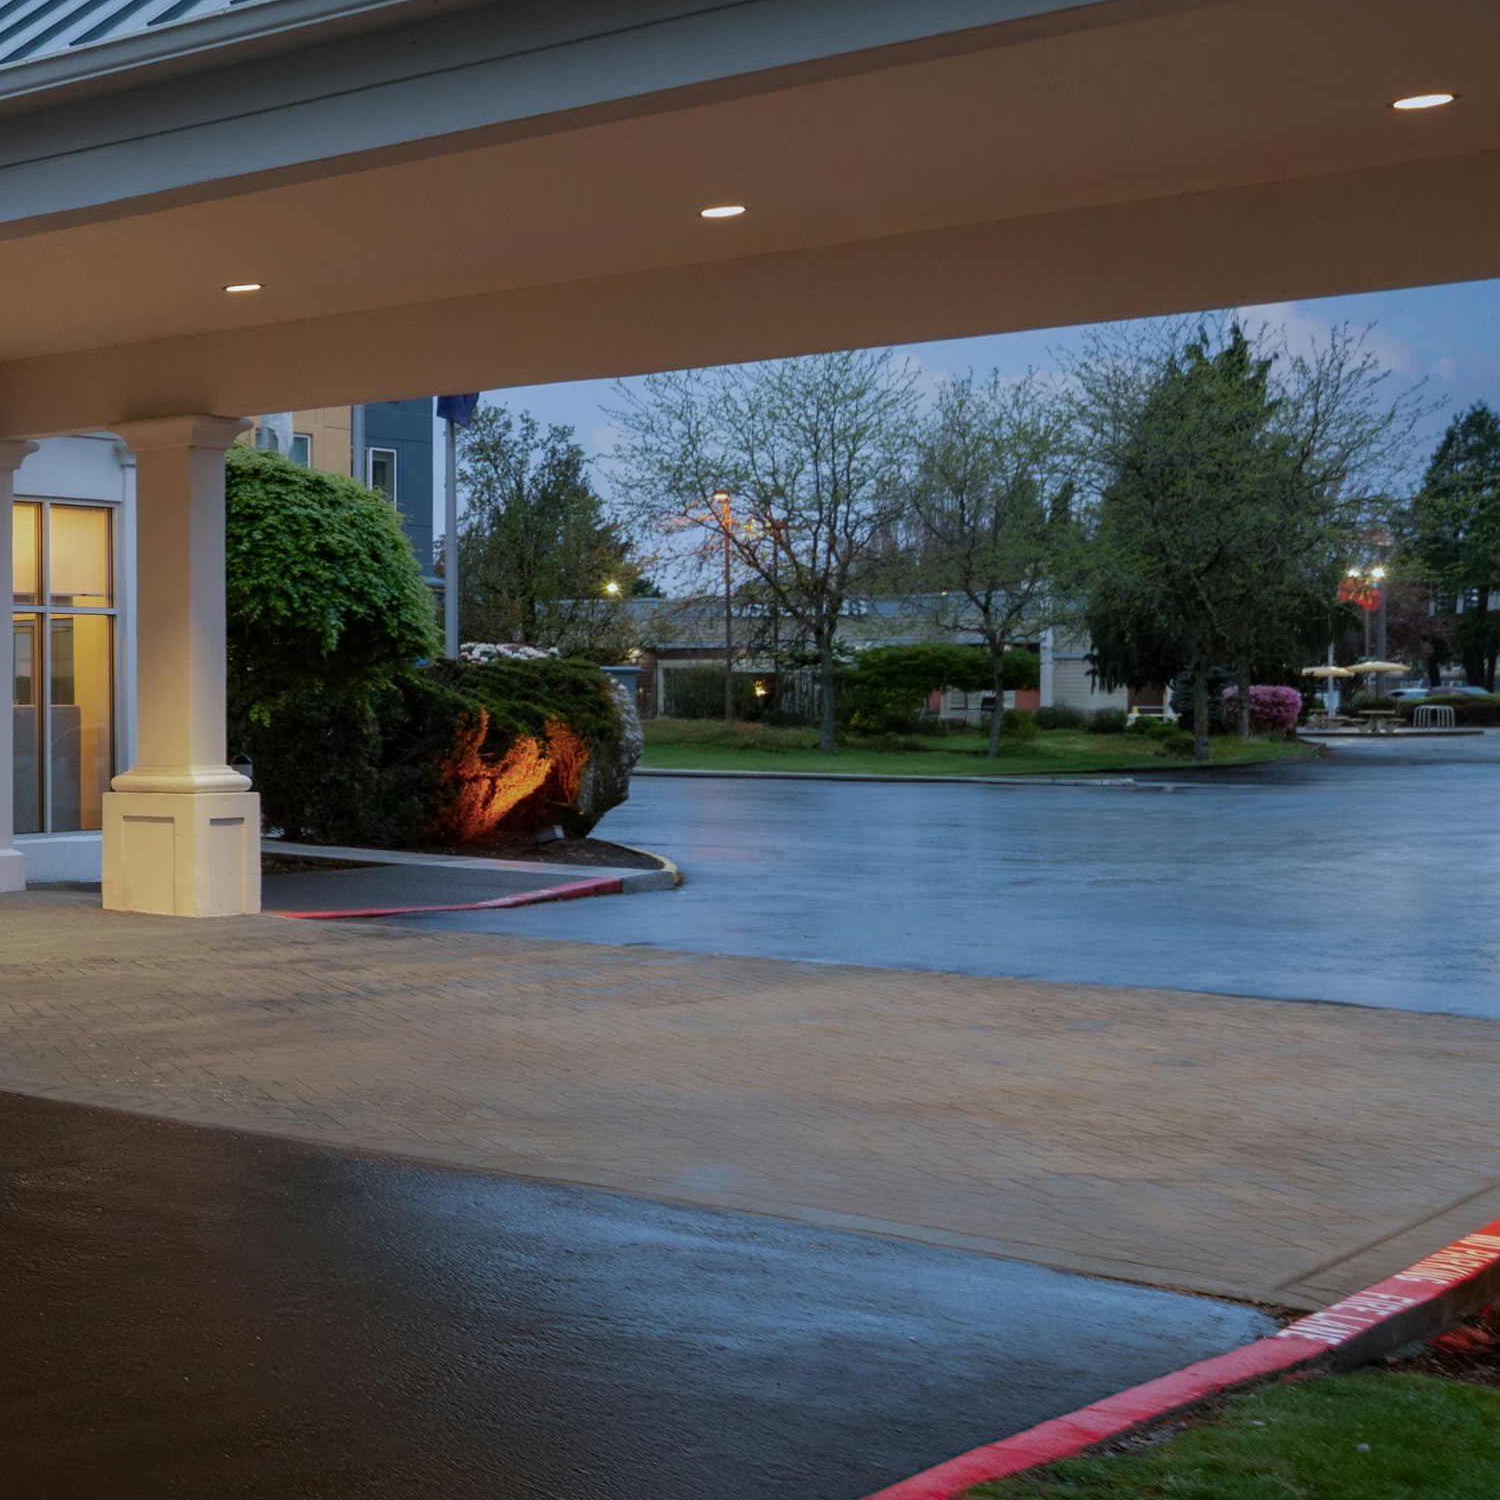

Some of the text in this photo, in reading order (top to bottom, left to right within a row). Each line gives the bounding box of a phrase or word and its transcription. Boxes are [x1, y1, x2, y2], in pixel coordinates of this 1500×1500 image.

[1392, 1245, 1500, 1286] PARKING
[1328, 1290, 1416, 1317] FIRE
[1275, 1311, 1375, 1346] LANE
